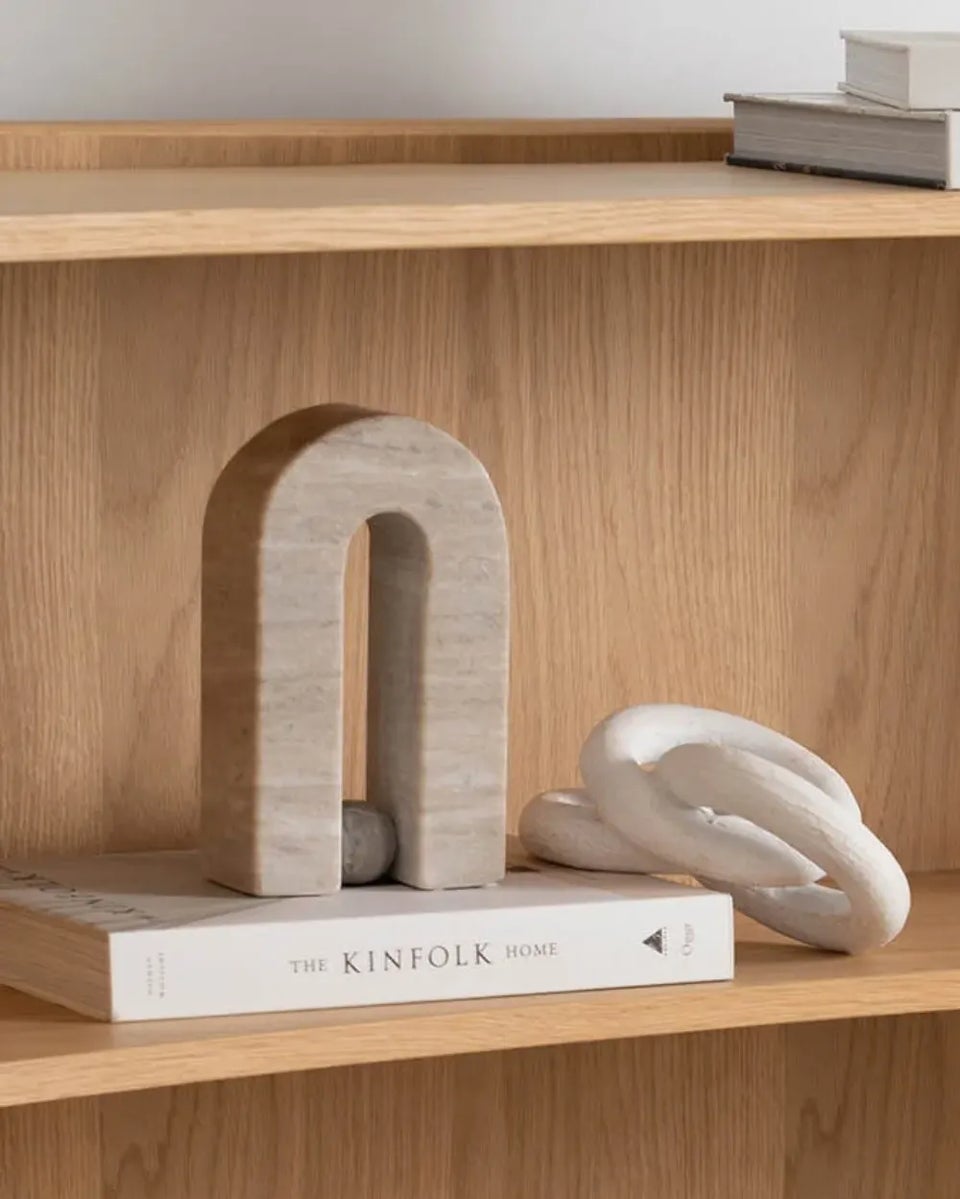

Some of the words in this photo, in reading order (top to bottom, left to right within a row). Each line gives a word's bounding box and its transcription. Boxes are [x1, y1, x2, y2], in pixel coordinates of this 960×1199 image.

[289, 959, 328, 974] THE
[342, 943, 492, 974] KINFOLK
[505, 942, 559, 959] HOME
